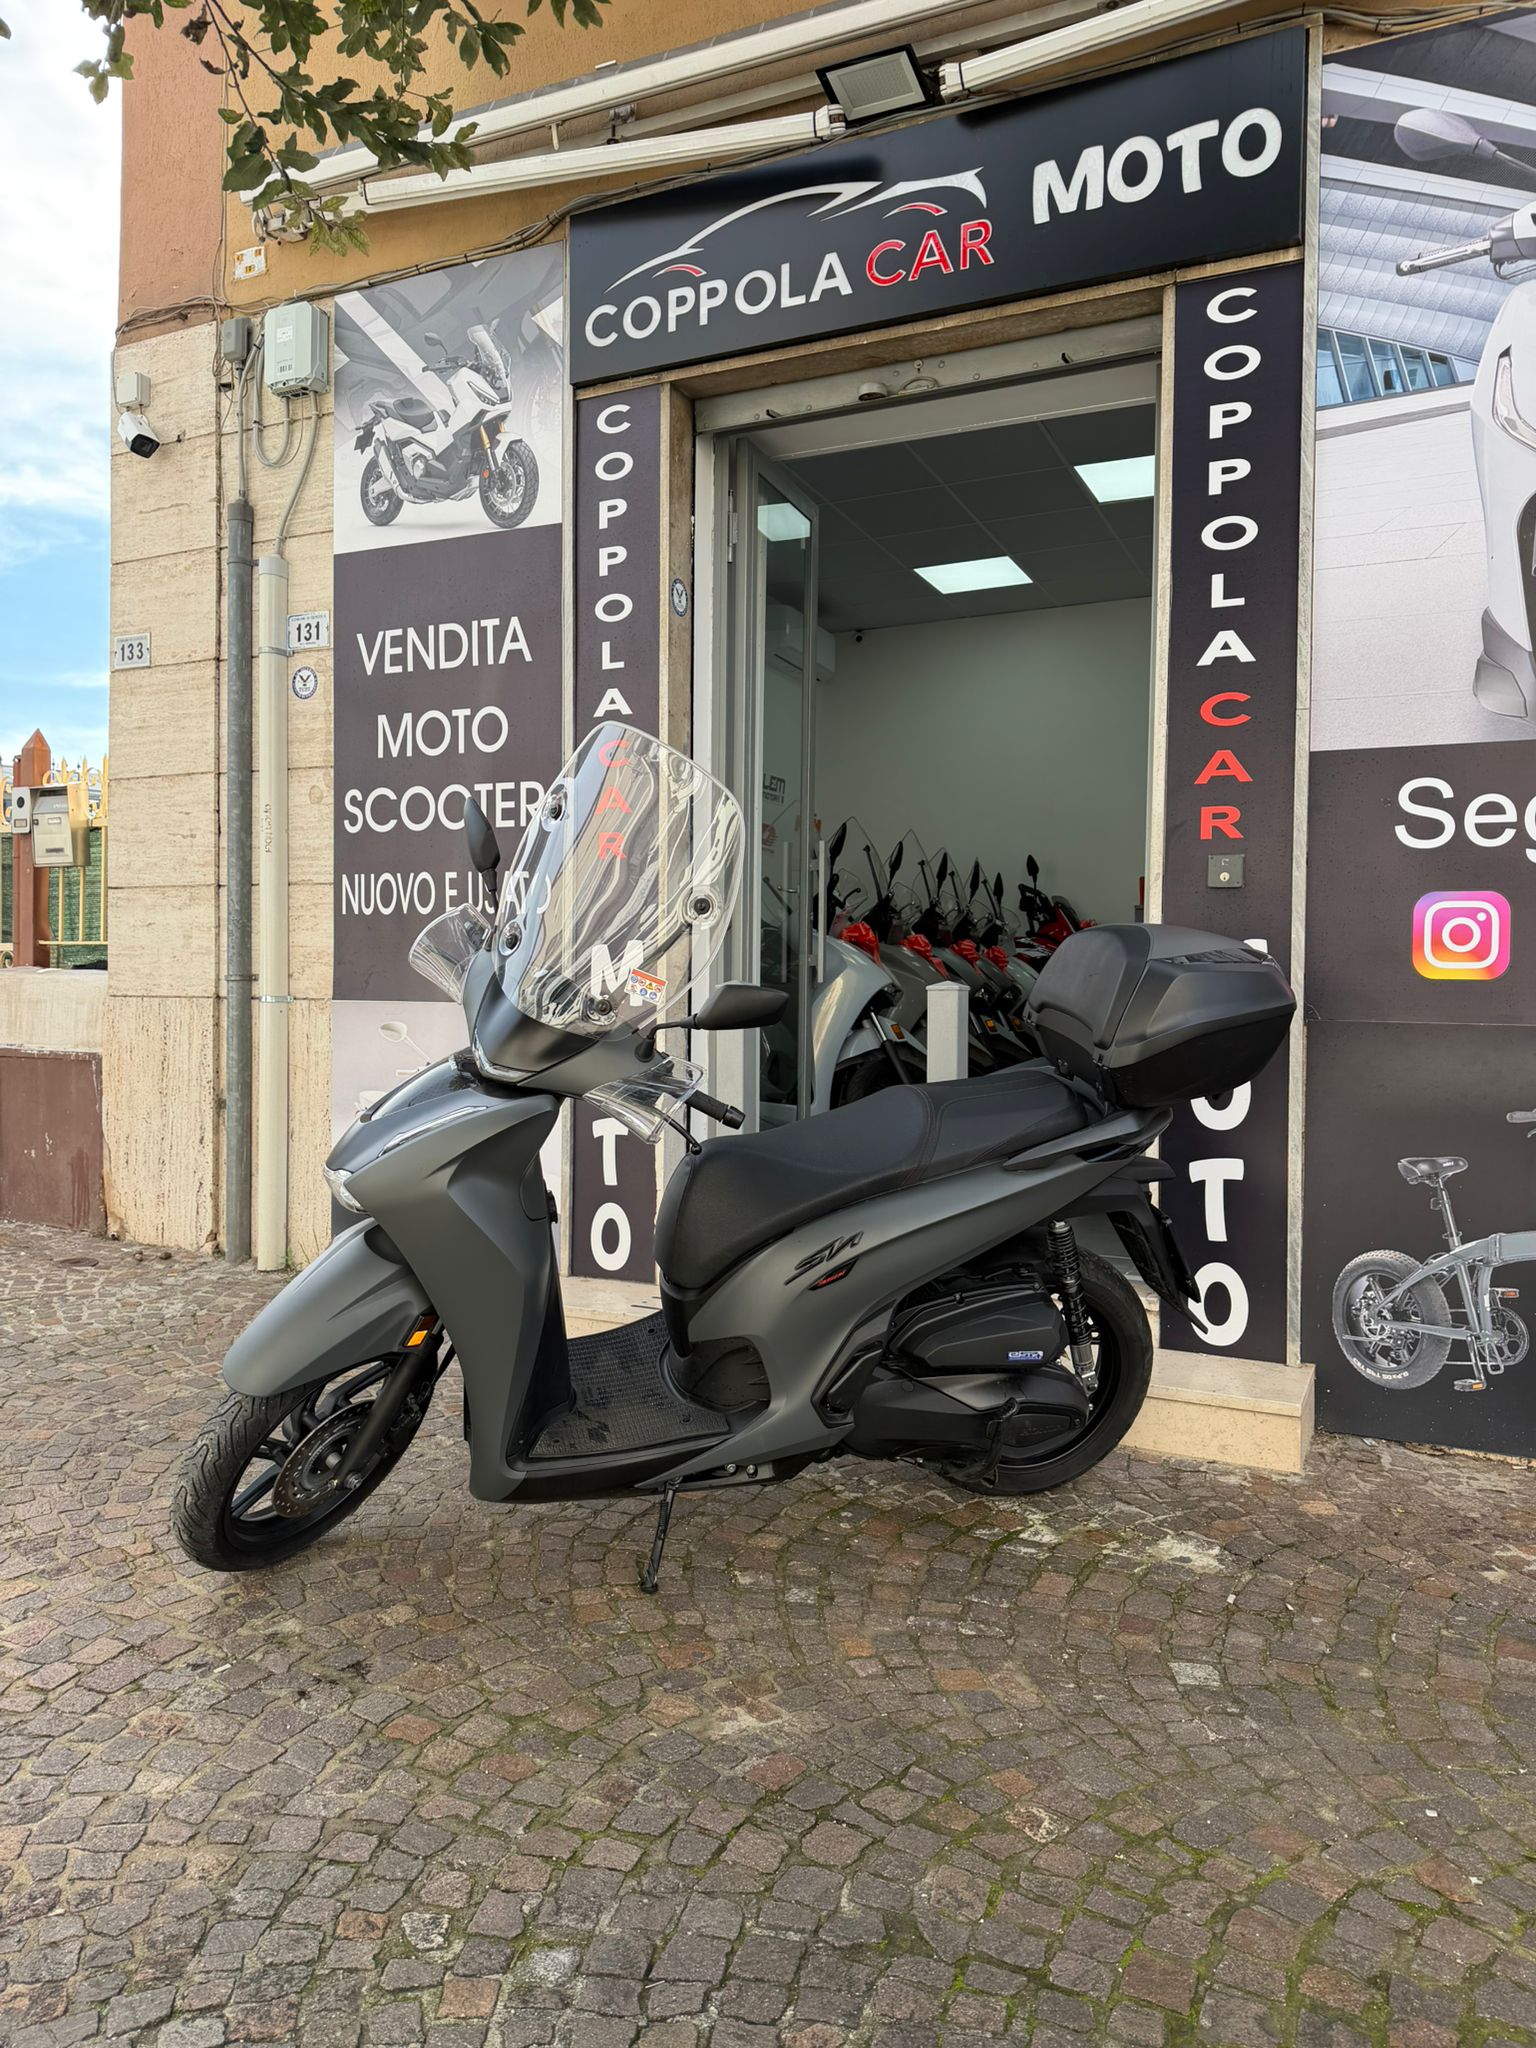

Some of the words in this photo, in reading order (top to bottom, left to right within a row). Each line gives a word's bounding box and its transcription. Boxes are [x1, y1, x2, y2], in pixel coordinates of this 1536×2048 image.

[584, 252, 853, 348] COPPOLA
[865, 218, 995, 288] CAR
[1032, 107, 1284, 226] MOTO
[1196, 286, 1262, 667] COPPOLA
[592, 403, 634, 718] COPPOLA
[120, 641, 144, 662] 133
[296, 621, 320, 643] 131
[356, 615, 533, 676] VENDITA
[377, 705, 509, 758] MOTO
[1194, 691, 1254, 841] CAR
[597, 739, 632, 860] CAR
[341, 871, 436, 916] NUOVO
[445, 870, 458, 913] E
[590, 939, 644, 1271] MTO
